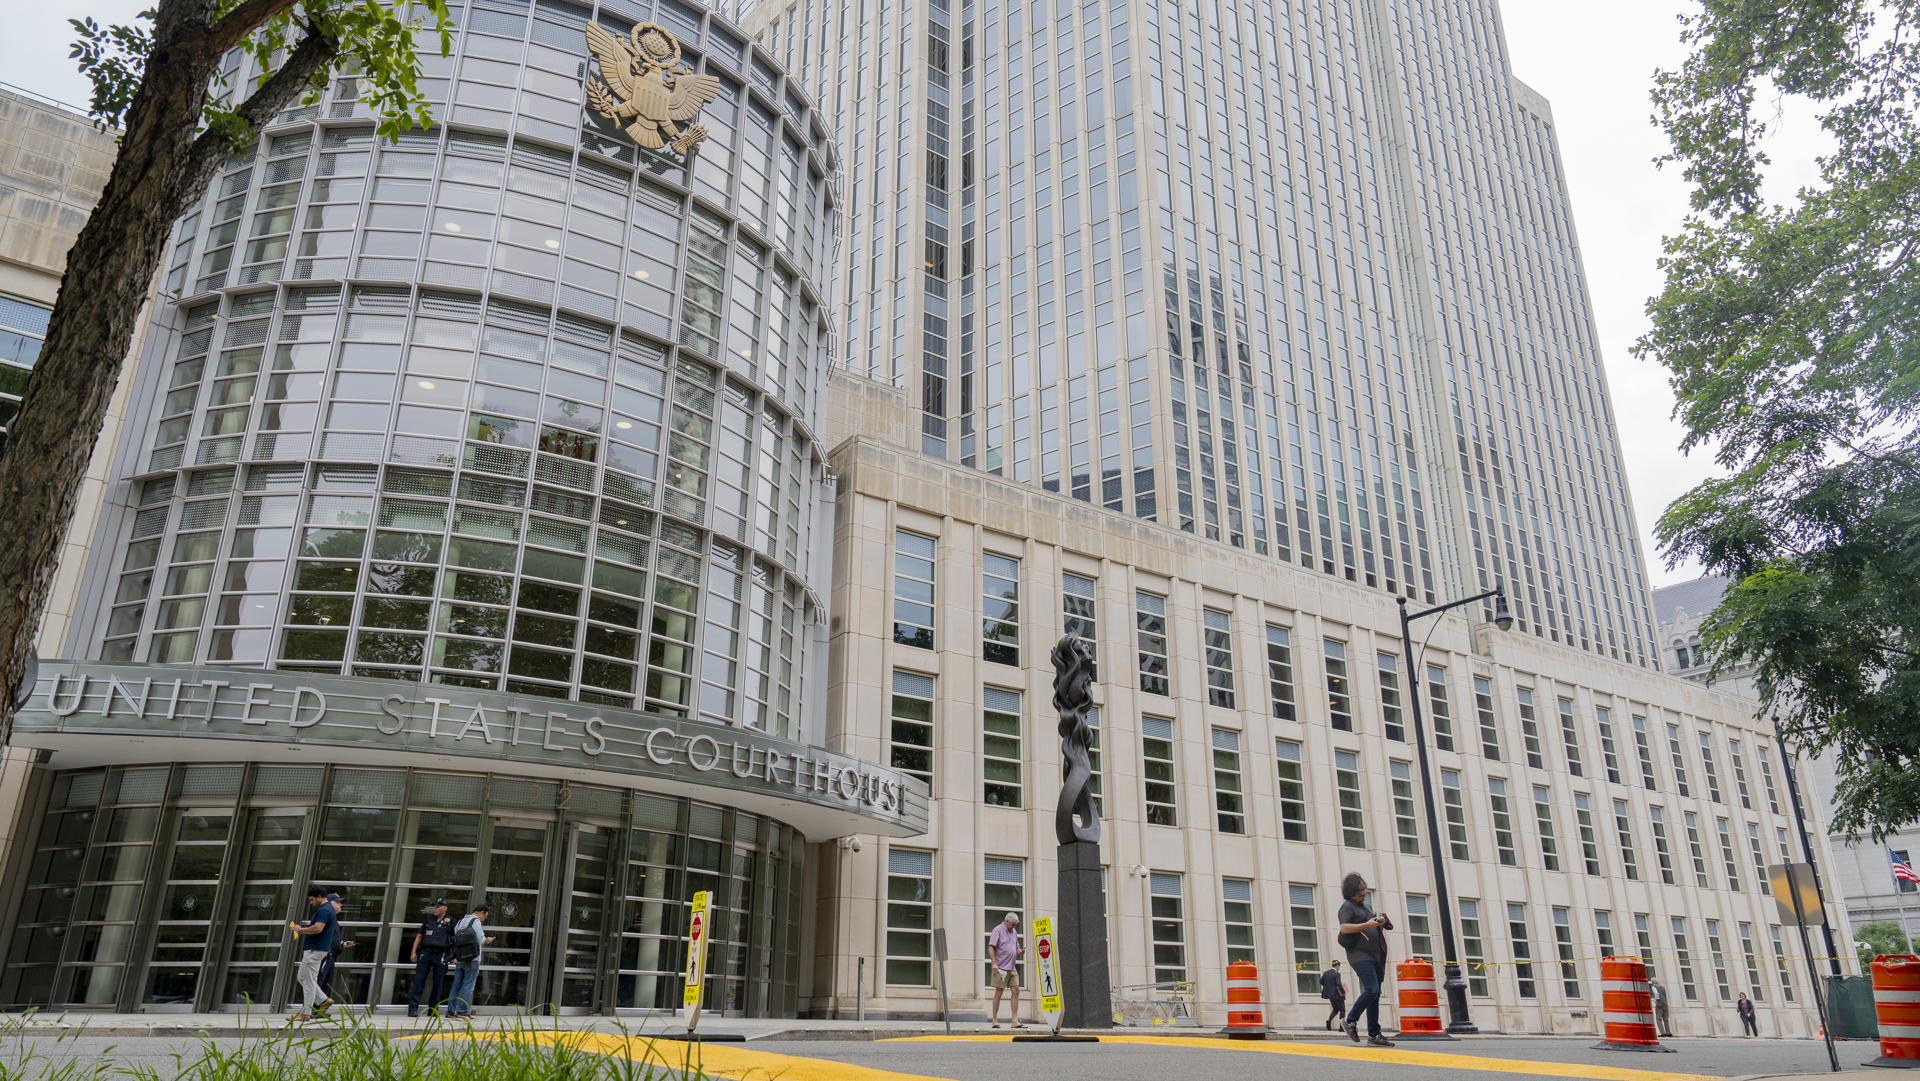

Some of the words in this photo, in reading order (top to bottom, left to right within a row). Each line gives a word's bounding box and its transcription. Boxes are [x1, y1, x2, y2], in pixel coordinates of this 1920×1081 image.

[47, 673, 328, 728] UNITED
[377, 693, 606, 756] STATES
[1035, 919, 1048, 927] STATE
[1039, 945, 1050, 953] STOP
